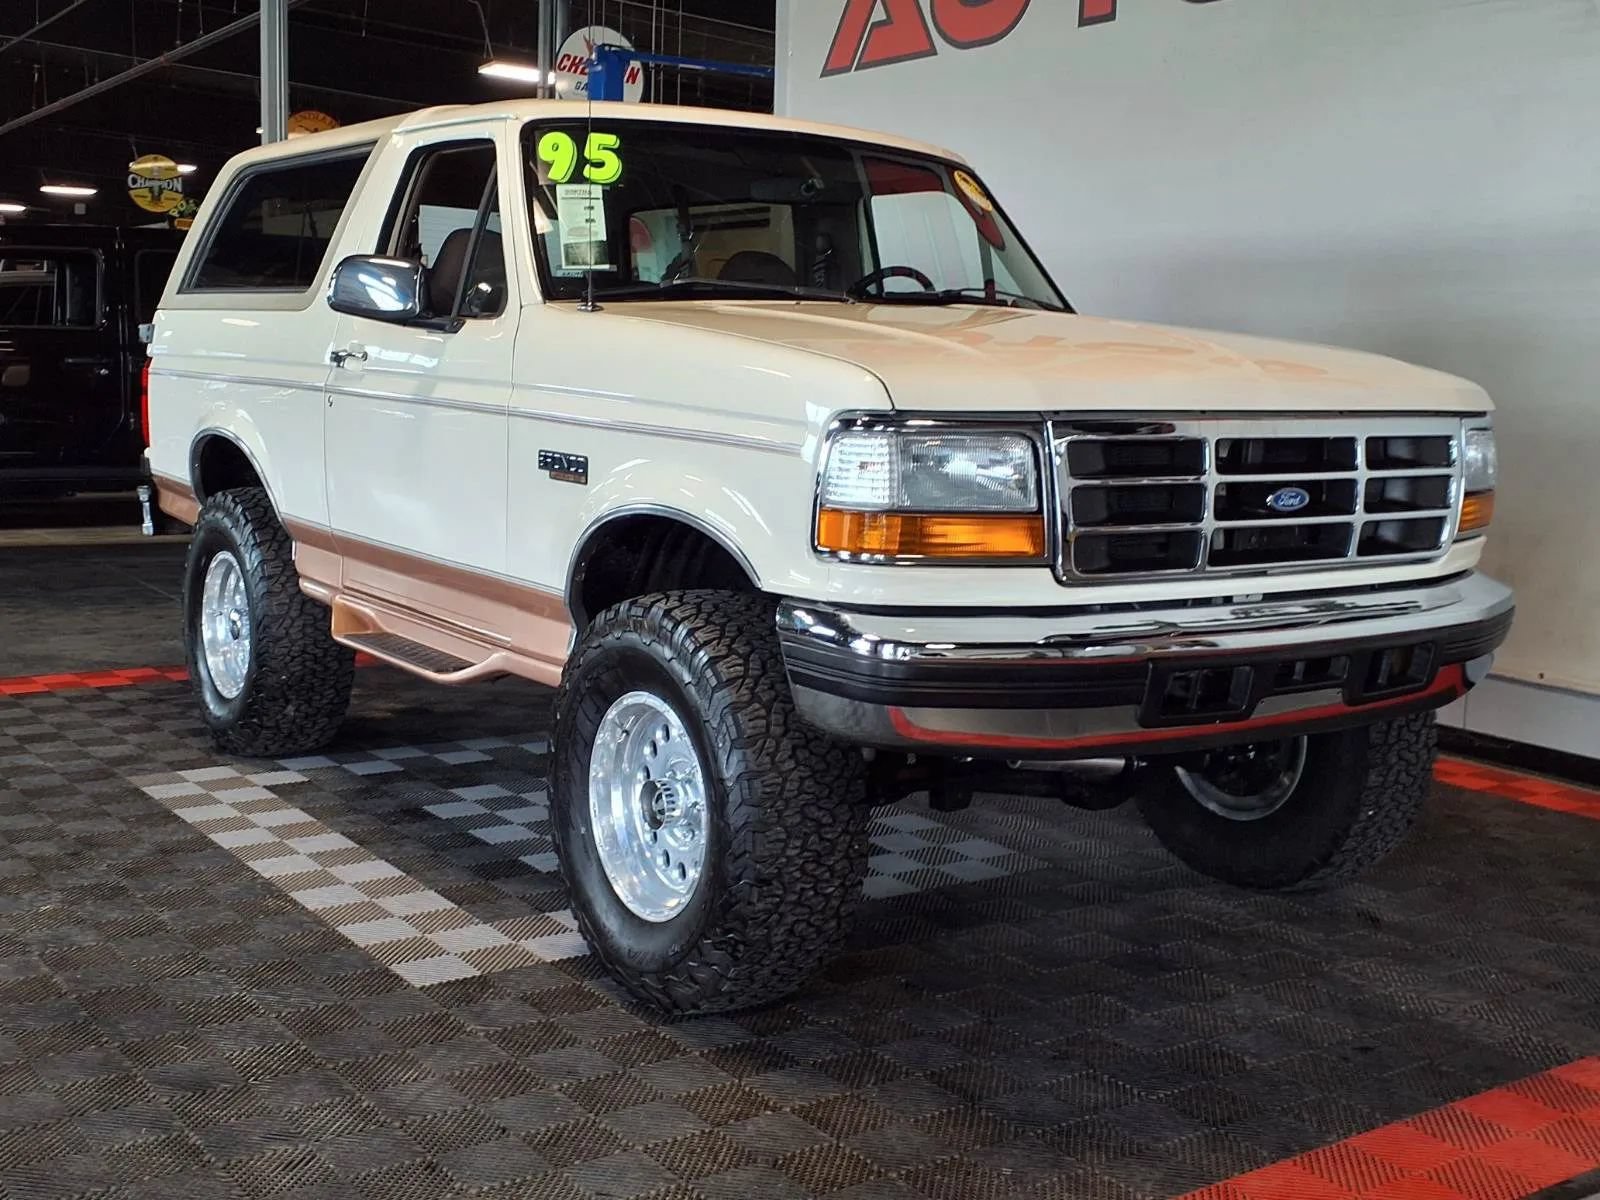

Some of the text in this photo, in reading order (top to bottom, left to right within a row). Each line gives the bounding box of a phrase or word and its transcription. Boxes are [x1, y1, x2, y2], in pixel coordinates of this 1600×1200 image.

[538, 131, 622, 184] 95
[127, 174, 183, 193] CHAION
[1277, 491, 1301, 506] Ford
